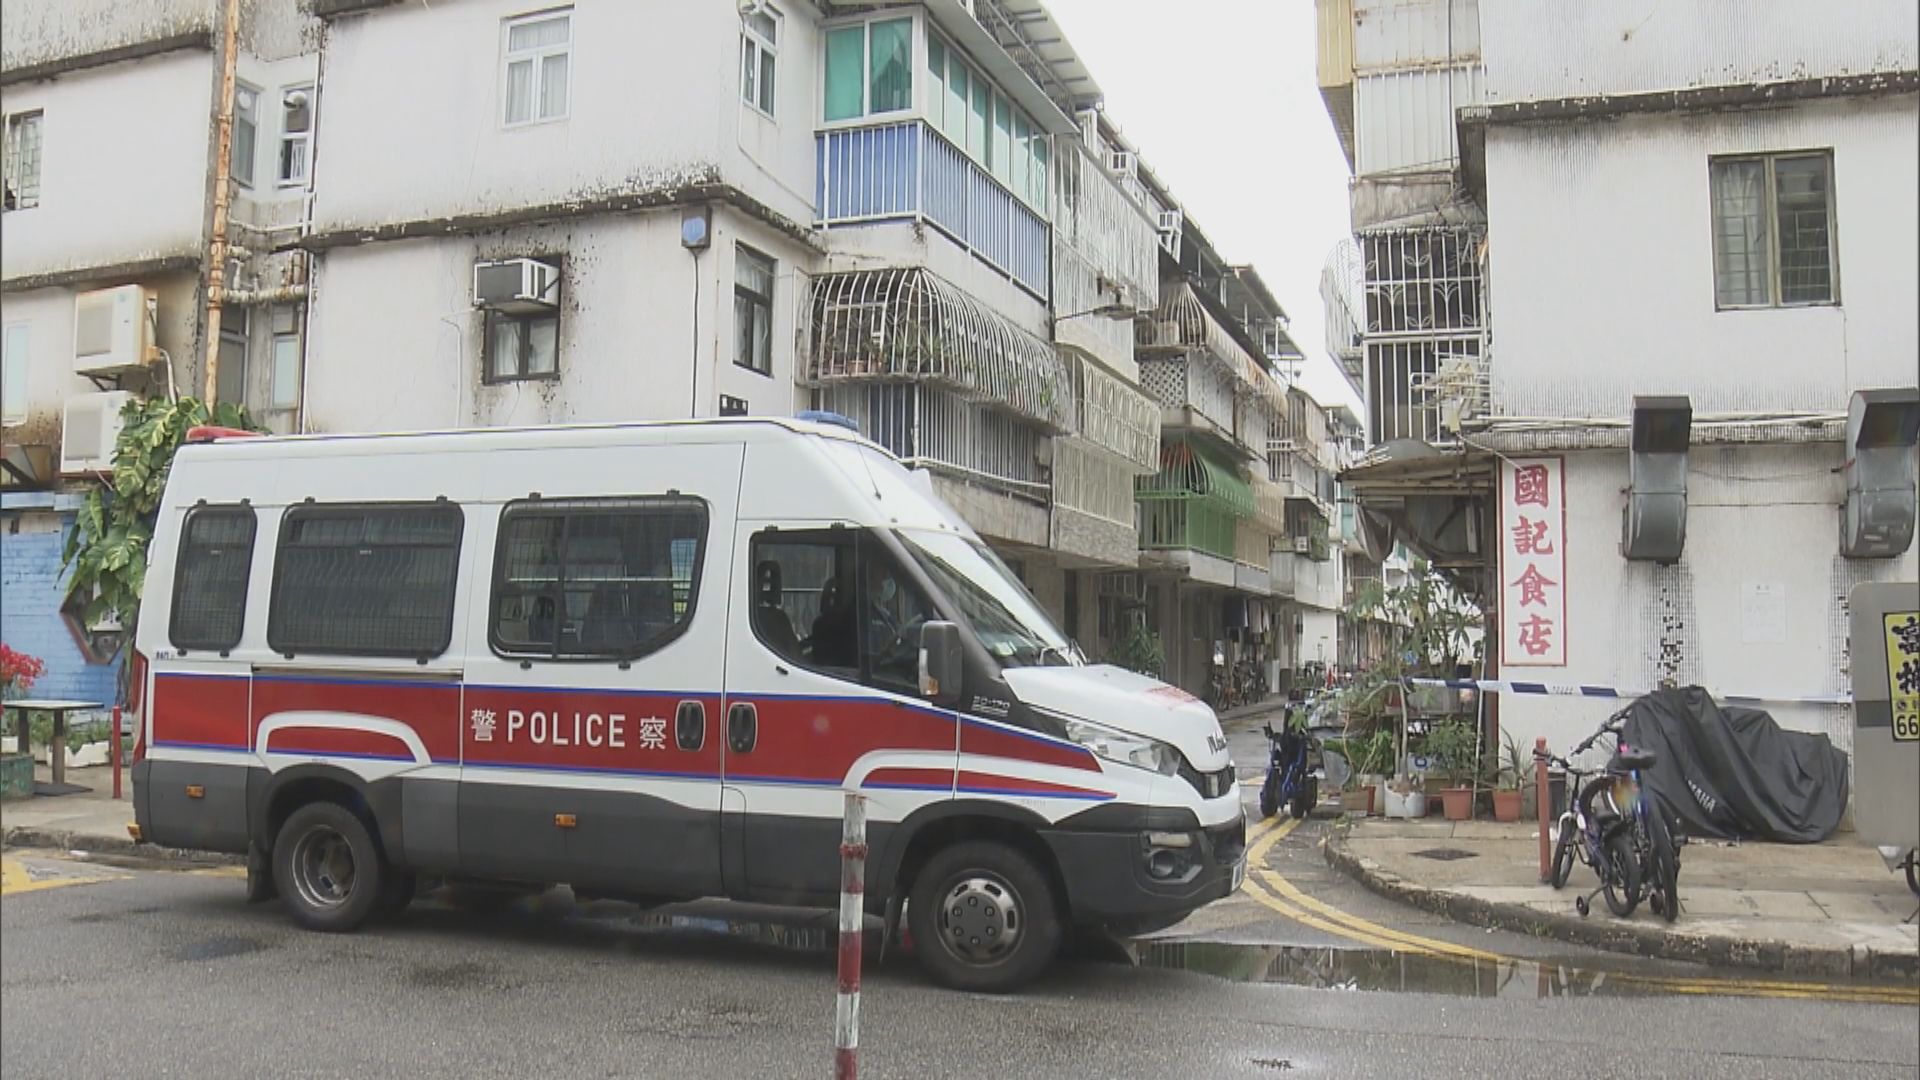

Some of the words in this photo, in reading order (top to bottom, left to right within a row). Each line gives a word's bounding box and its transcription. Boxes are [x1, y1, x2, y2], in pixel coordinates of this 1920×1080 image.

[1510, 464, 1557, 656] 國記食店
[471, 708, 497, 742] 警
[507, 710, 626, 748] POLICE
[639, 716, 667, 750] 察
